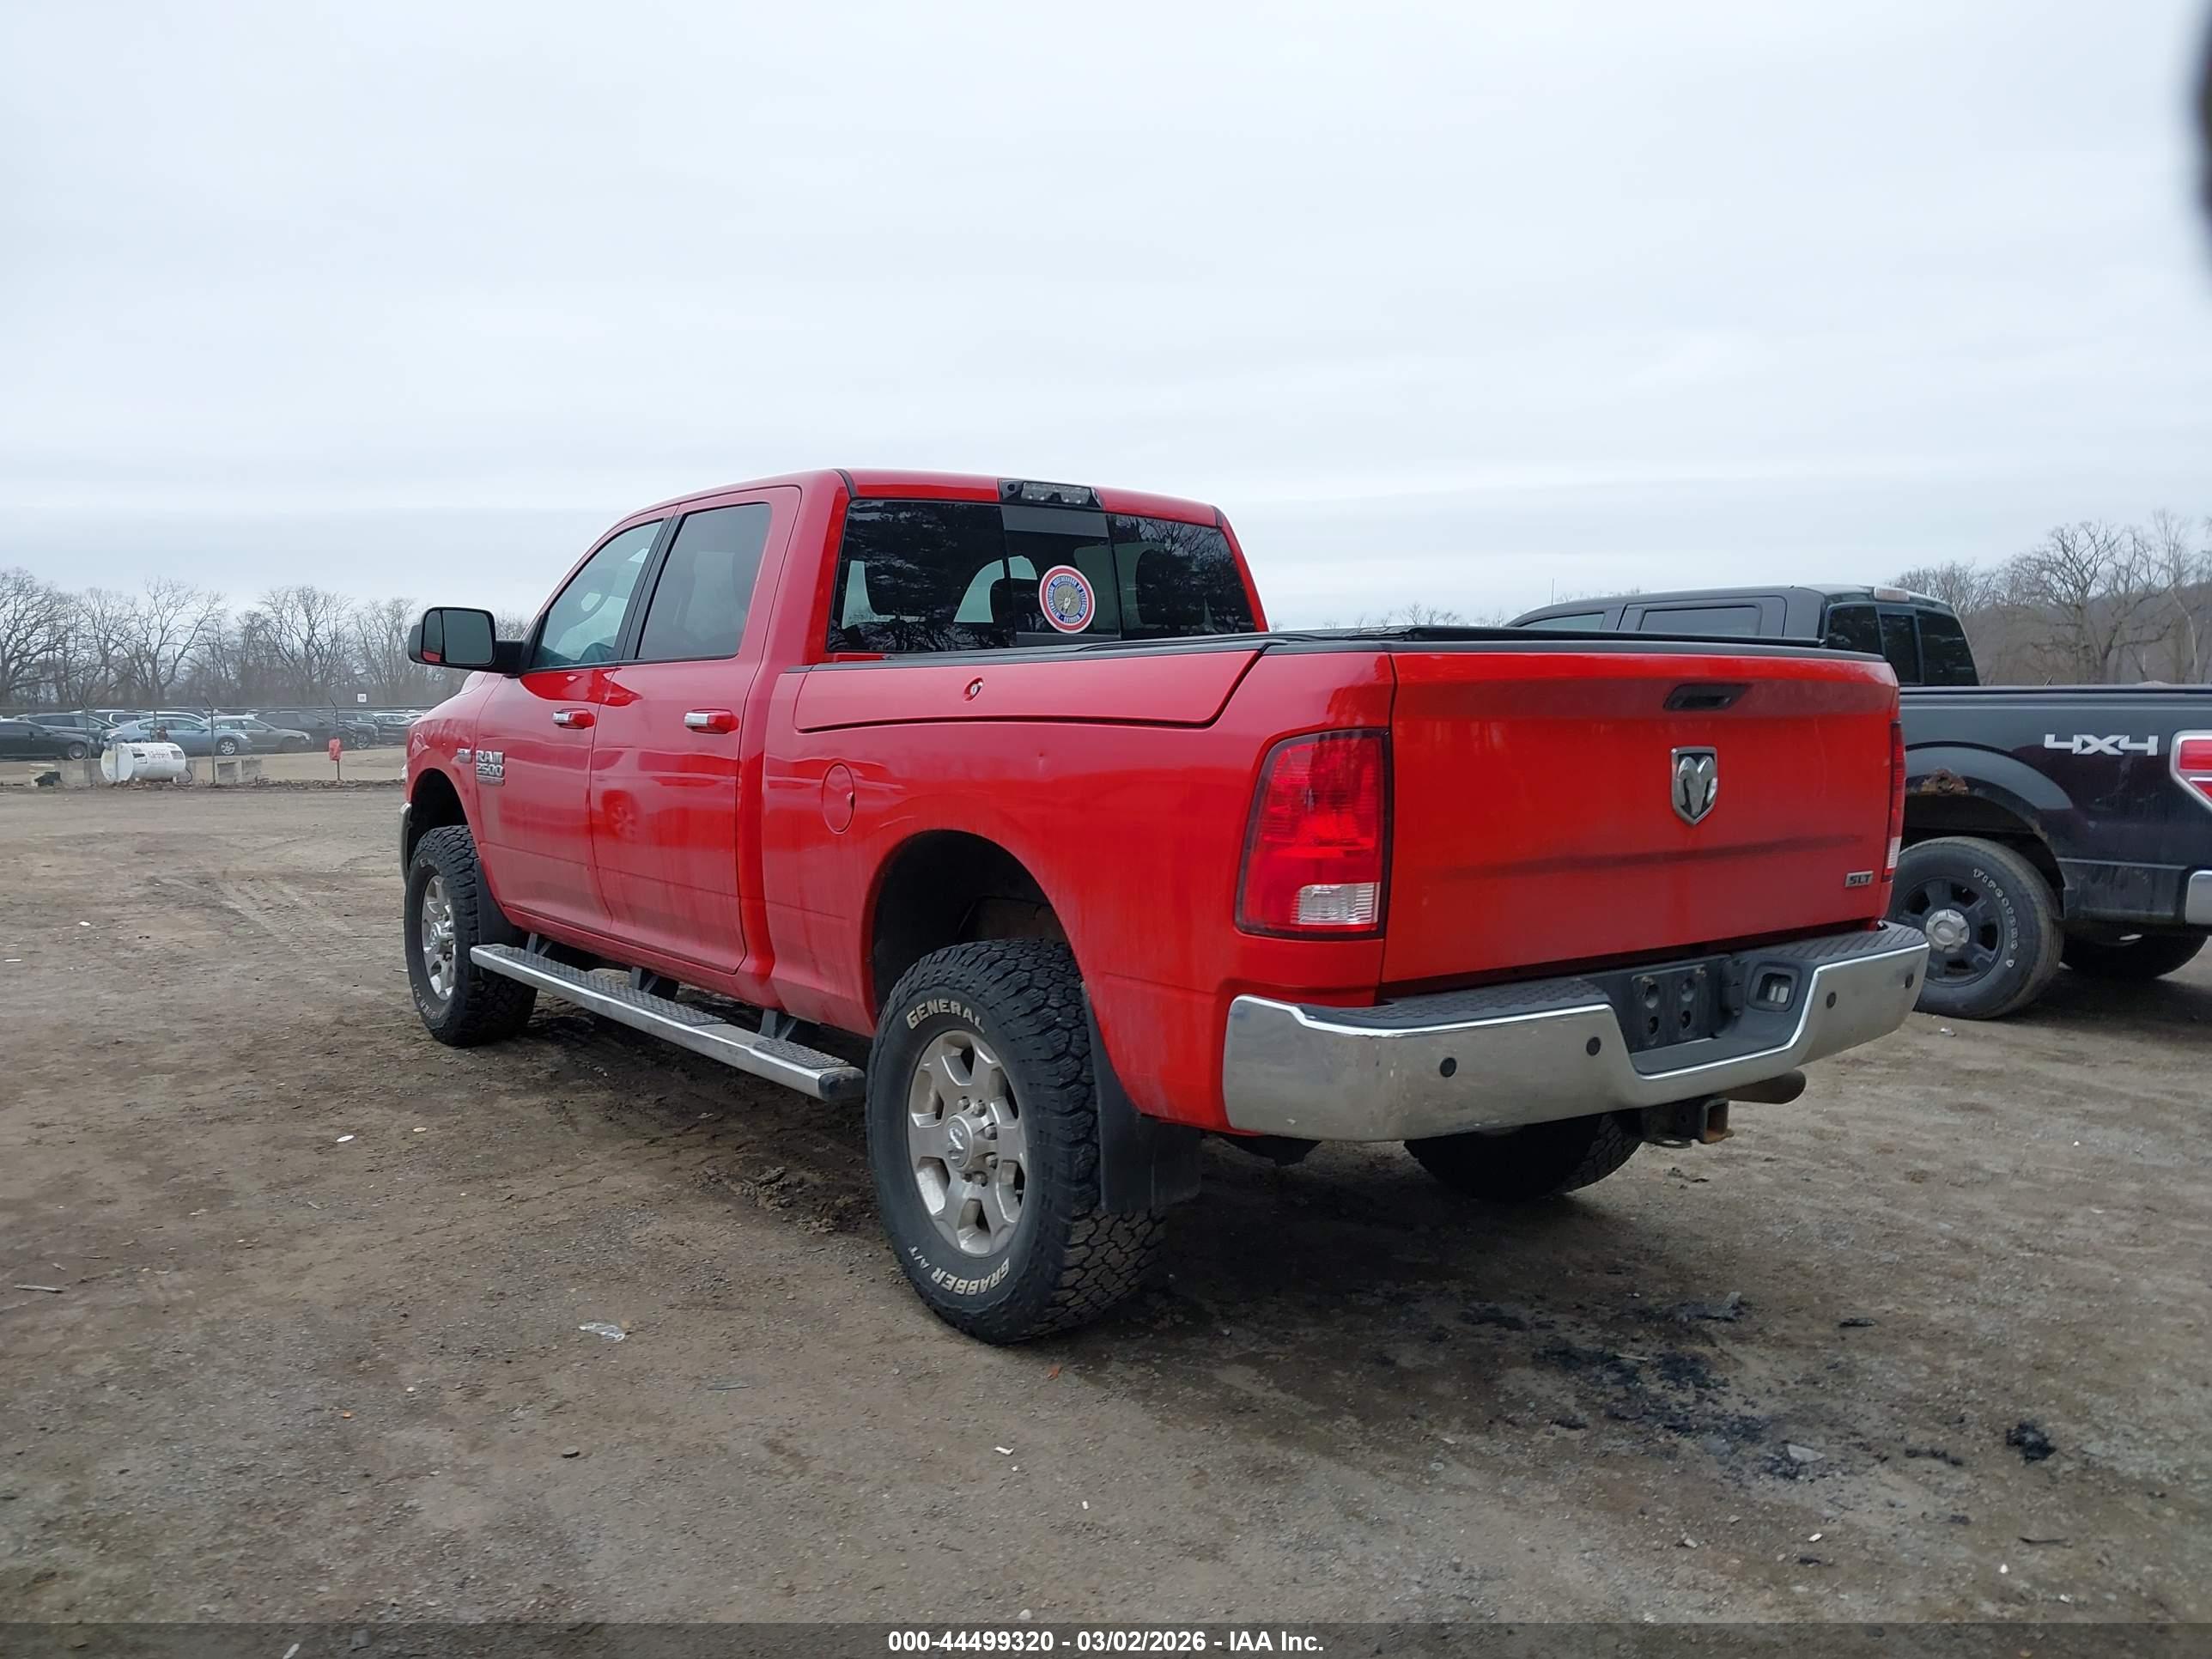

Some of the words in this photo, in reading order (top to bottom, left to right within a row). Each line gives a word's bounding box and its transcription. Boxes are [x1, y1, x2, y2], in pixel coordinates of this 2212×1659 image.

[476, 750, 504, 763] RAM
[1850, 874, 1871, 885] SLT
[906, 999, 986, 1034] GENERAL
[930, 1256, 1011, 1297] GRABBER
